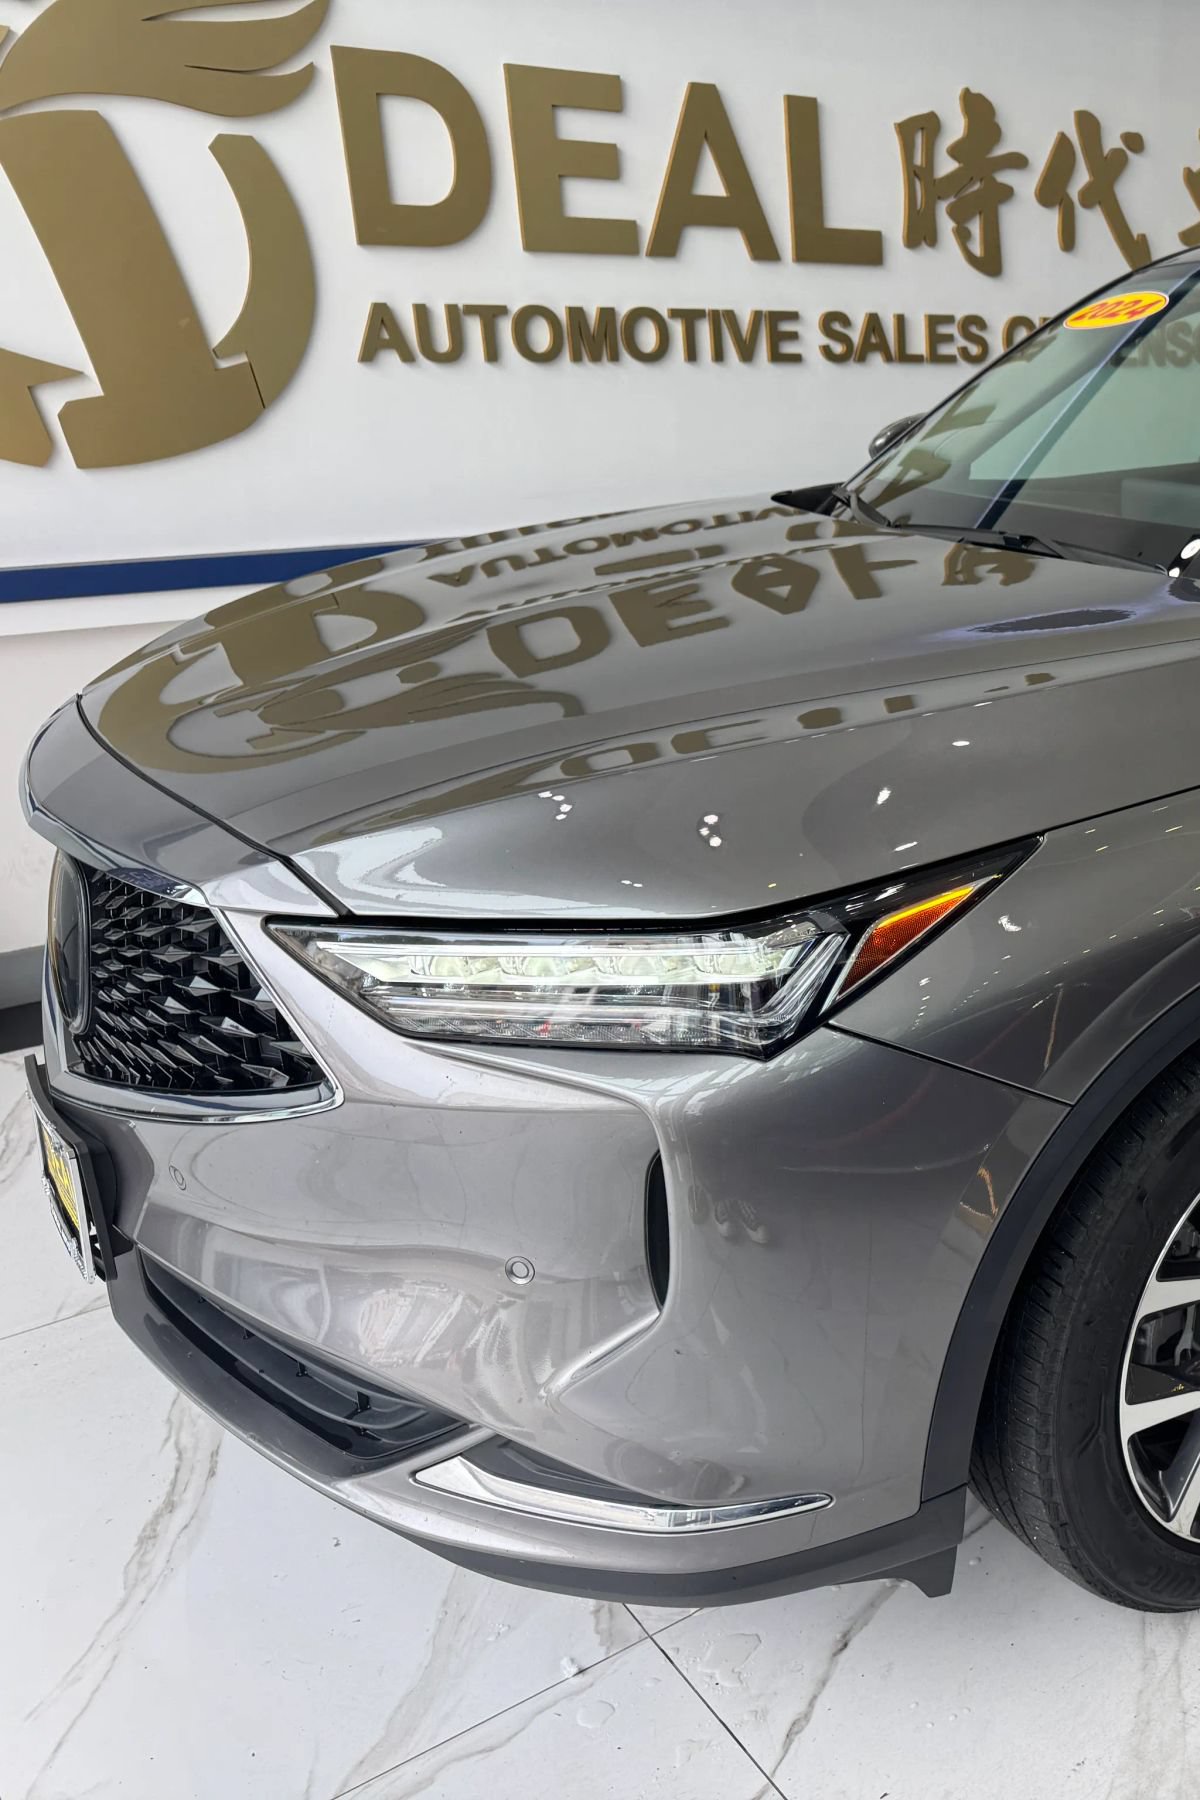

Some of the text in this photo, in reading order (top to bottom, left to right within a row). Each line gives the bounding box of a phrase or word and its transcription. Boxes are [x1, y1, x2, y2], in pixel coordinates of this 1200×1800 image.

[329, 44, 884, 266] DEAL
[357, 302, 803, 364] AUTOMOTIVE
[818, 310, 989, 365] SALES
[1070, 299, 1163, 323] 2024
